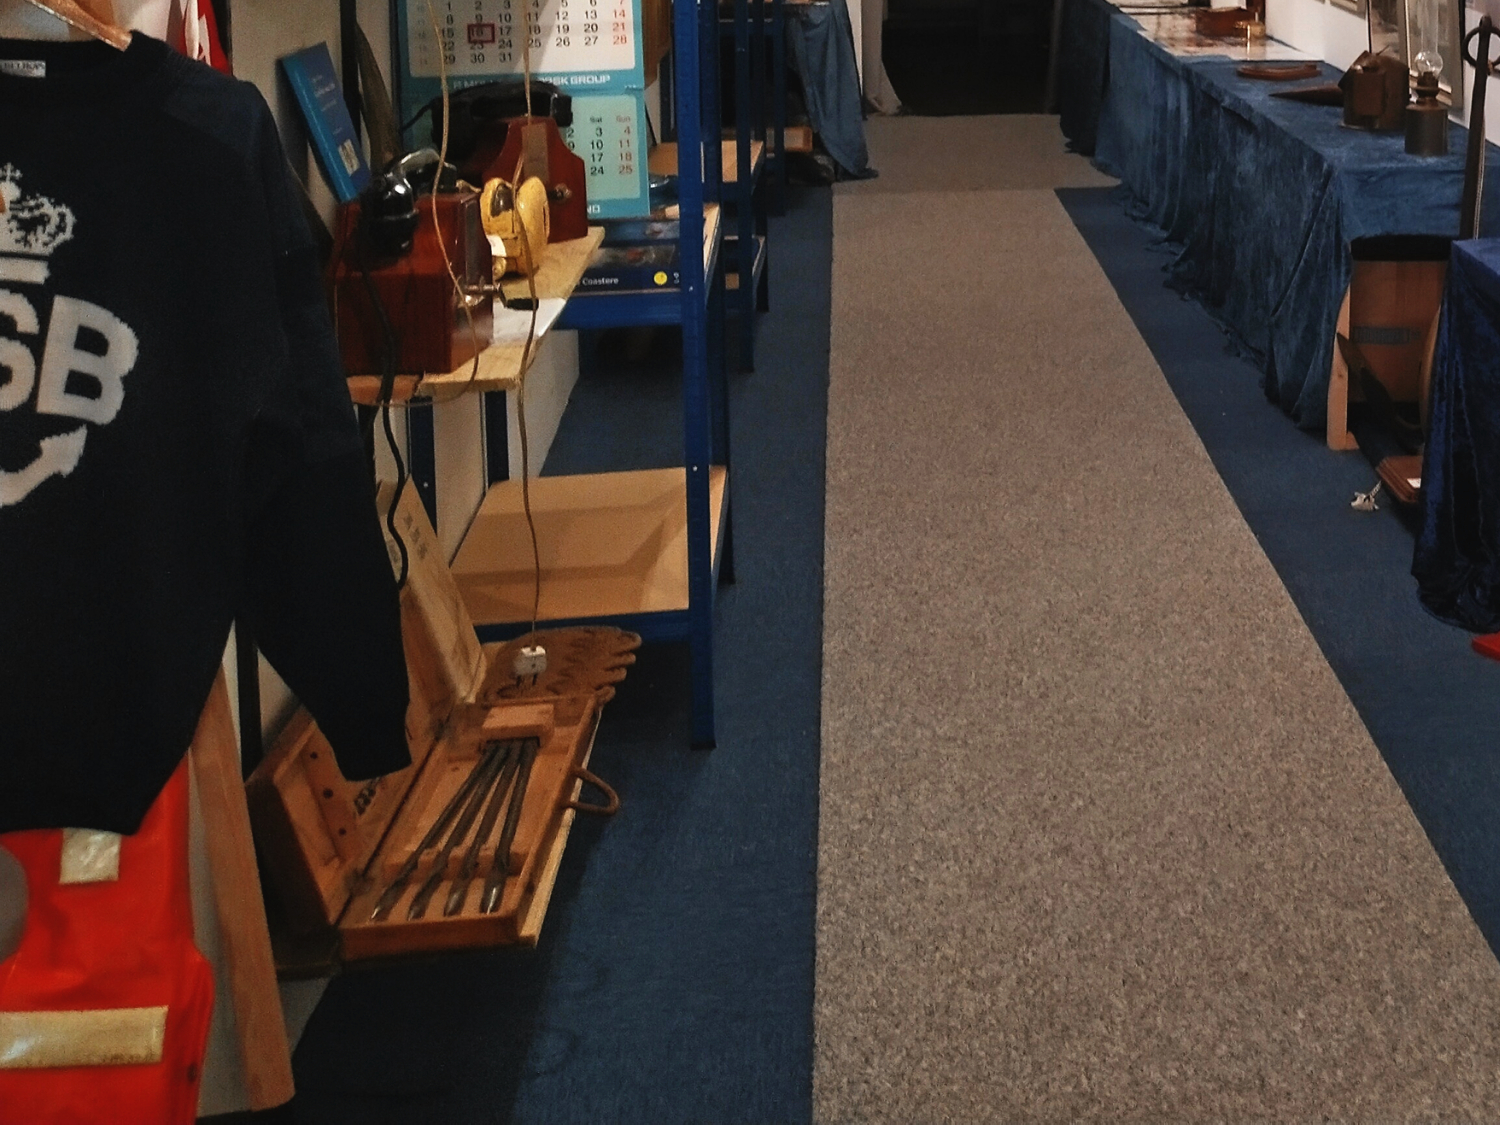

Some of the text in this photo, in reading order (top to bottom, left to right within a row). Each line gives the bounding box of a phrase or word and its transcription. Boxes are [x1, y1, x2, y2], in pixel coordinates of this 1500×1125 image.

[474, 0, 482, 11] 2
[503, 0, 511, 9] 3
[532, 0, 539, 8] 4
[499, 12, 512, 23] 10
[527, 12, 539, 22] 11
[556, 11, 569, 21] 12
[584, 9, 598, 20] 13
[613, 9, 626, 18] 14
[499, 26, 512, 36] 17
[528, 25, 541, 35] 18
[557, 24, 570, 34] 19
[583, 23, 599, 33] 20
[612, 22, 625, 31] 21
[498, 40, 512, 50] 24
[528, 38, 541, 48] 25
[556, 37, 570, 47] 26
[584, 36, 598, 46] 27
[613, 35, 627, 45] 28
[471, 53, 485, 64] 30
[499, 52, 512, 62] 31
[570, 74, 612, 85] GROUP
[595, 126, 603, 137] 3
[624, 126, 631, 135] 4
[590, 139, 604, 150] 10
[619, 139, 630, 148] 11
[591, 152, 632, 162] 17 18
[590, 165, 633, 176] 24 25
